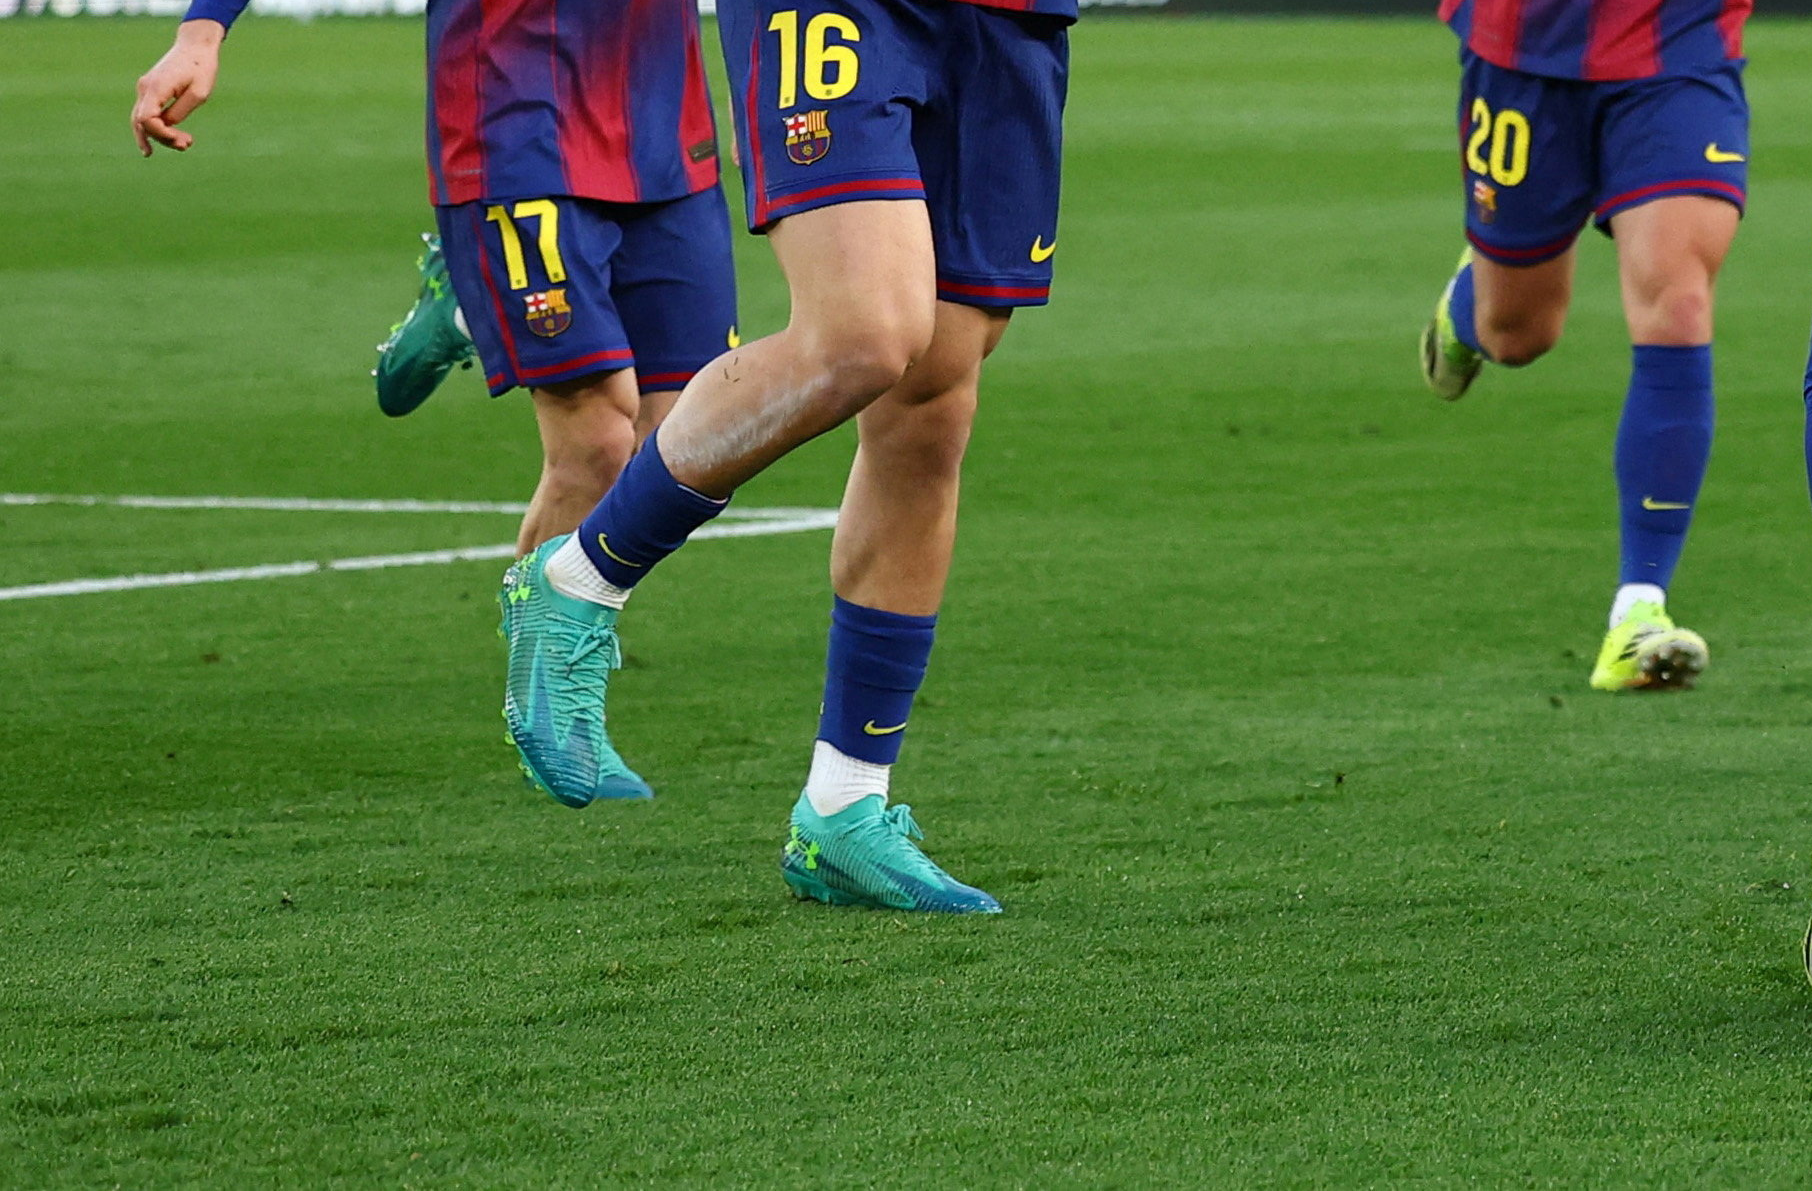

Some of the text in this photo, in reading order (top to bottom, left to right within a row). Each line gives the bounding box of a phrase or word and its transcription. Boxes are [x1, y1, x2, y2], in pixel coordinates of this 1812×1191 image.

[767, 9, 861, 110] 16
[1466, 95, 1532, 187] 20
[485, 198, 567, 290] 17
